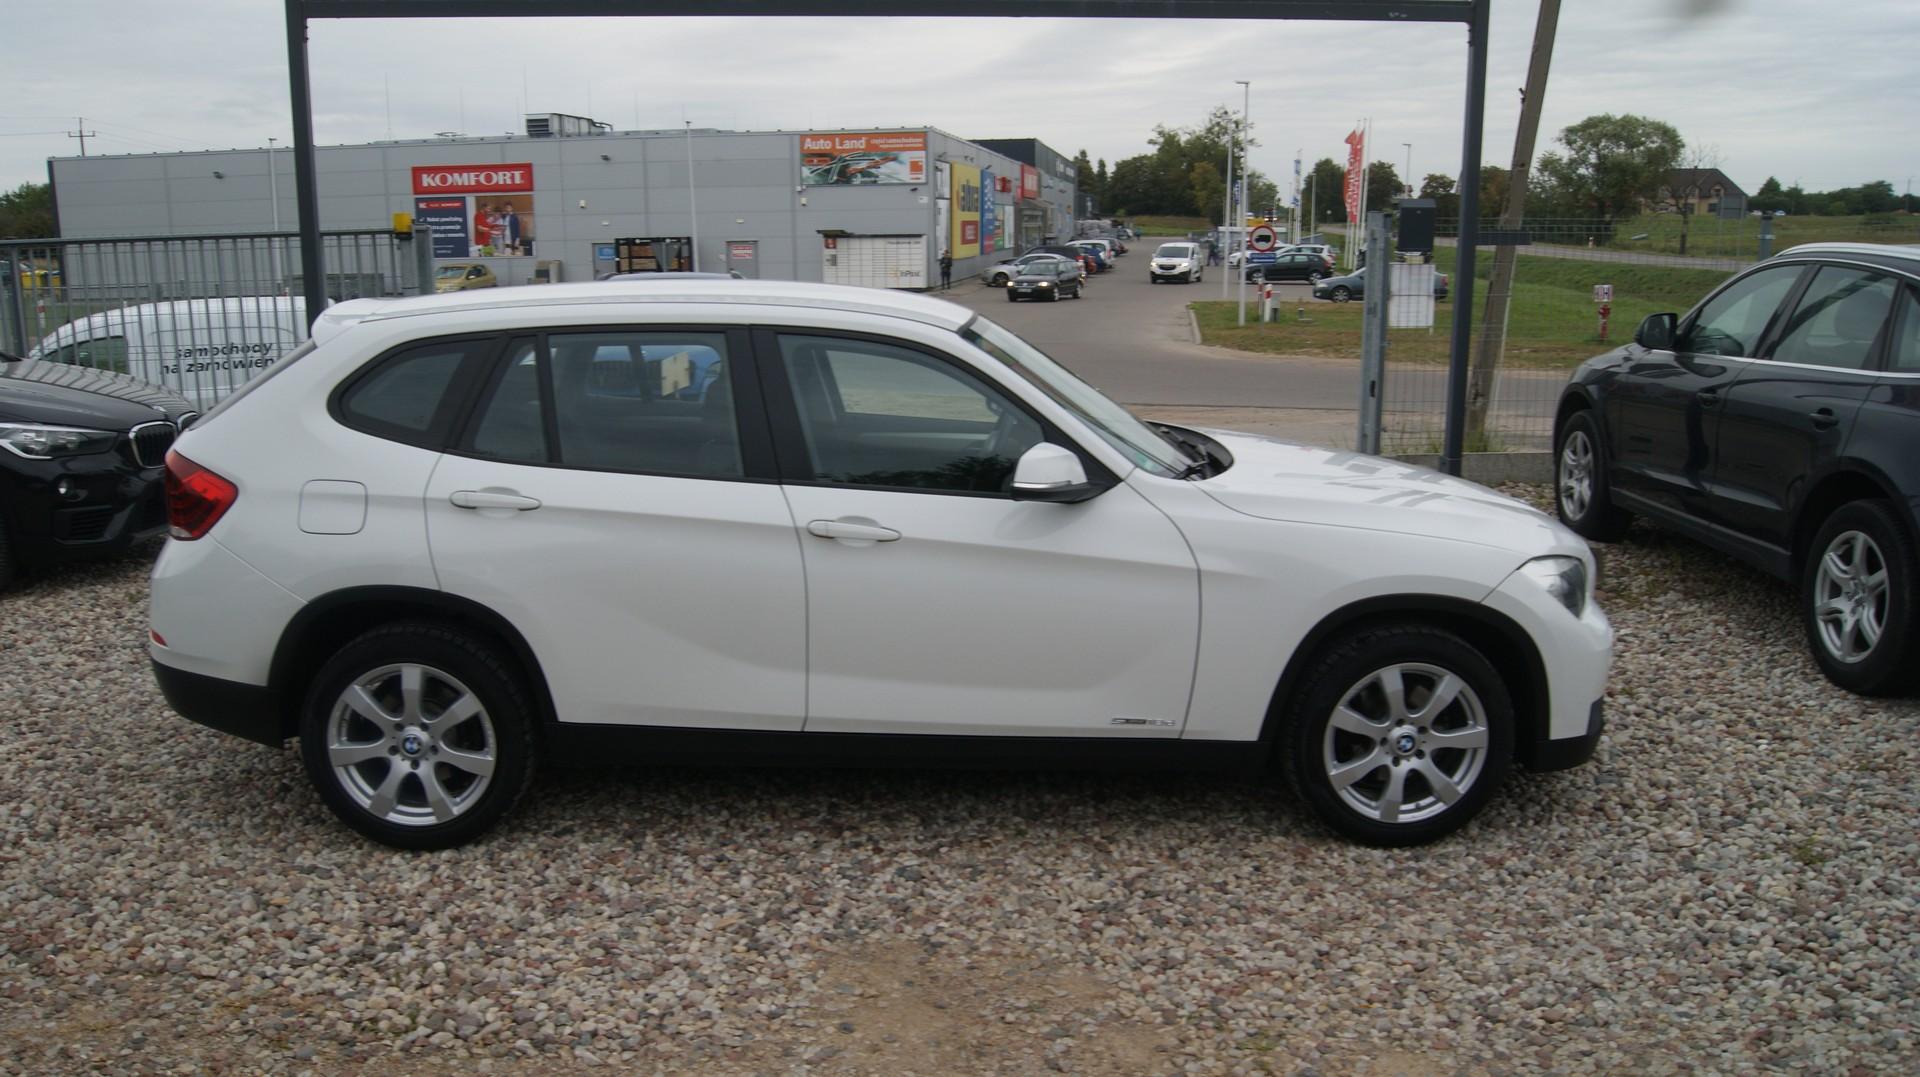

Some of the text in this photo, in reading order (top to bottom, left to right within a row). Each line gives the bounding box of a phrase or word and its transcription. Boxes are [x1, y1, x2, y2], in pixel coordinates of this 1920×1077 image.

[804, 137, 866, 150] Auto Land
[421, 170, 525, 187] KOMFORT
